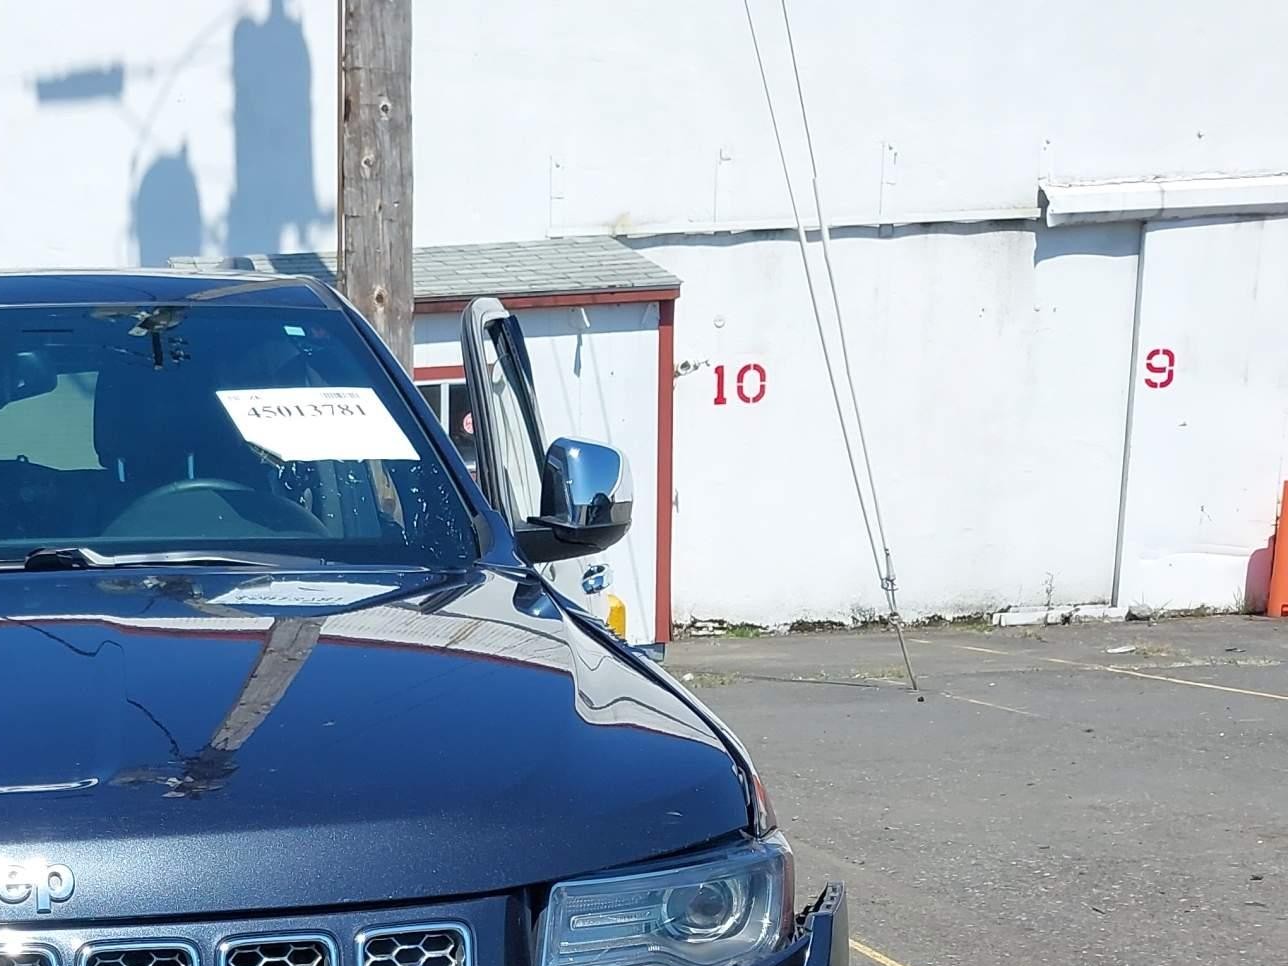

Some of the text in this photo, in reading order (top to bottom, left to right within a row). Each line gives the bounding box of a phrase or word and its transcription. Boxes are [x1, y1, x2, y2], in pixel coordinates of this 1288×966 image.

[714, 363, 766, 405] 10
[1144, 349, 1175, 388] 9
[247, 404, 367, 419] 45013781
